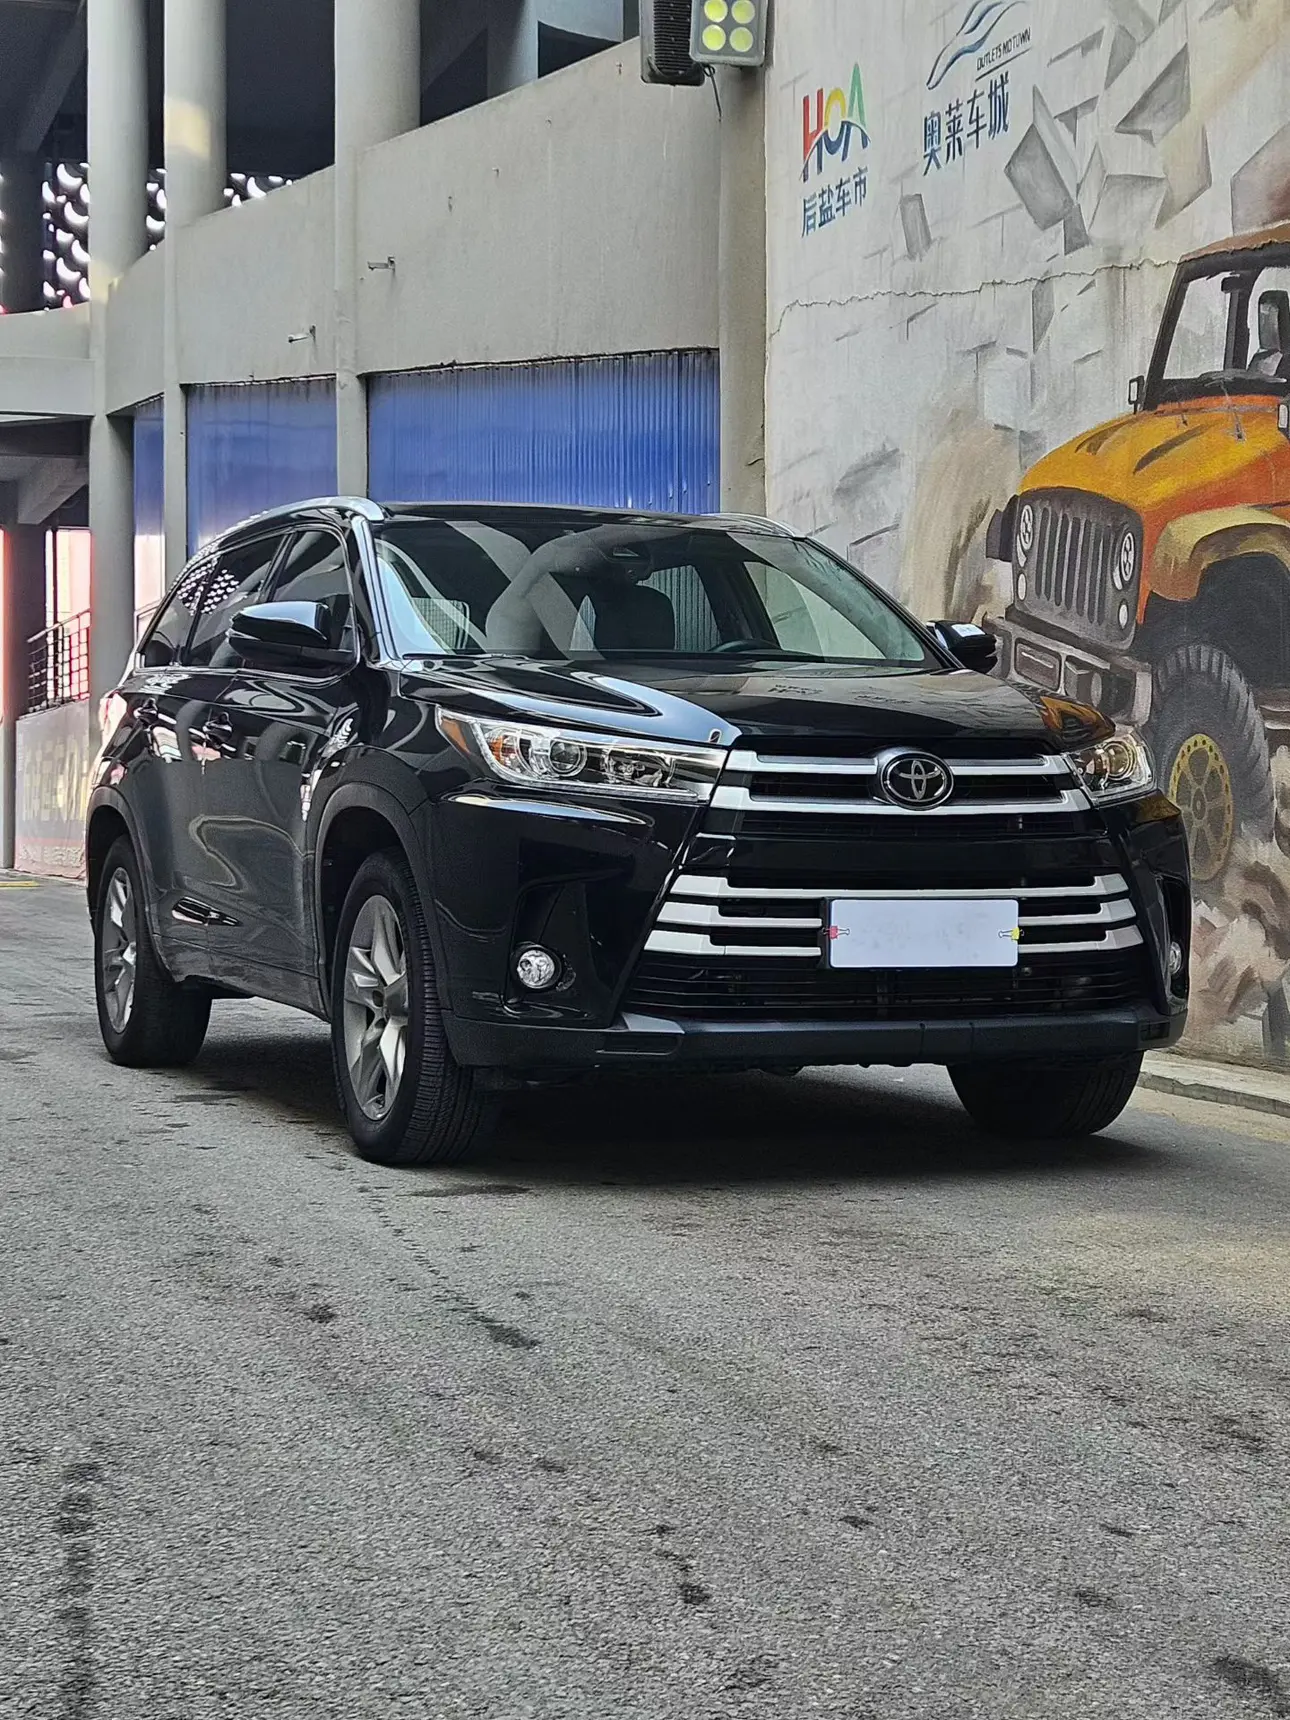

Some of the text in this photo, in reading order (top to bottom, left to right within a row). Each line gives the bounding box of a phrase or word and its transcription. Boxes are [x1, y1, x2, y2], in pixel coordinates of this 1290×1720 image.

[976, 43, 1002, 71] OUTLETS
[923, 71, 1010, 176] 奥莱车城
[801, 165, 868, 238] 后盐车市
